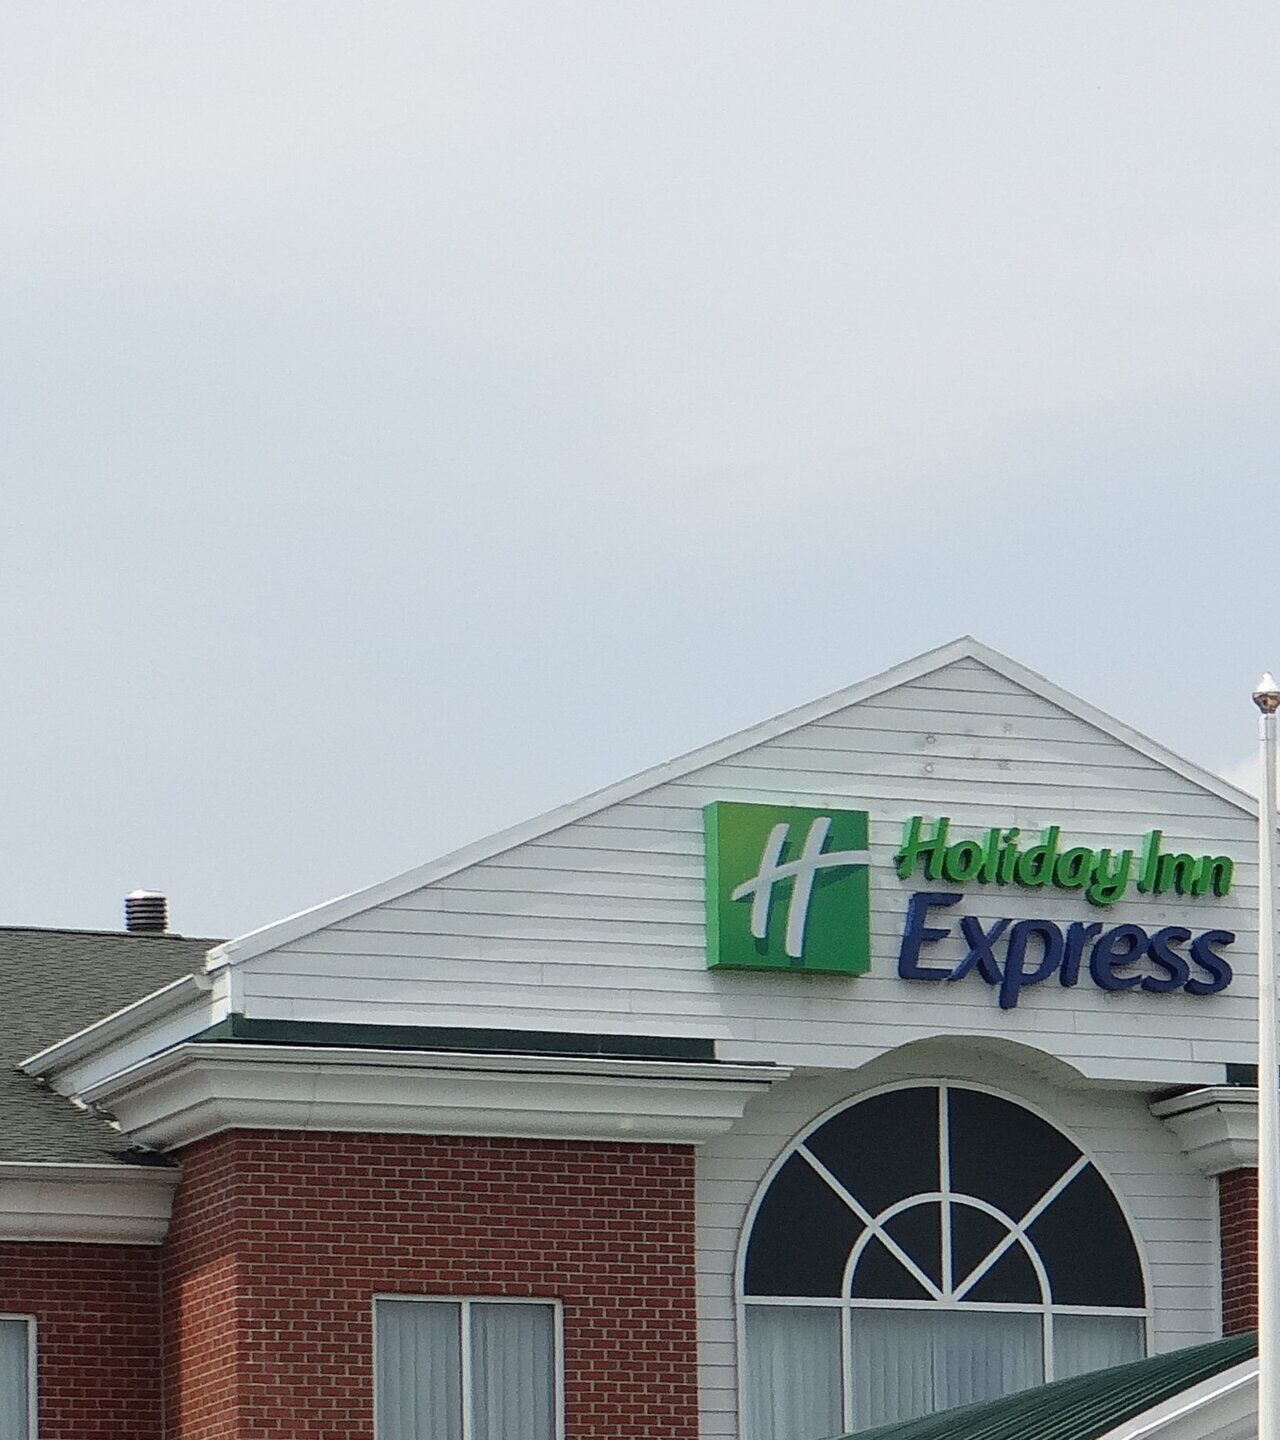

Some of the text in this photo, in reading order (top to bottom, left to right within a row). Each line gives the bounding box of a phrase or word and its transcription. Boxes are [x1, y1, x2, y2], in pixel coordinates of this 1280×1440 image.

[893, 816, 1235, 905] Holiday Inn
[899, 891, 1236, 1010] Express
